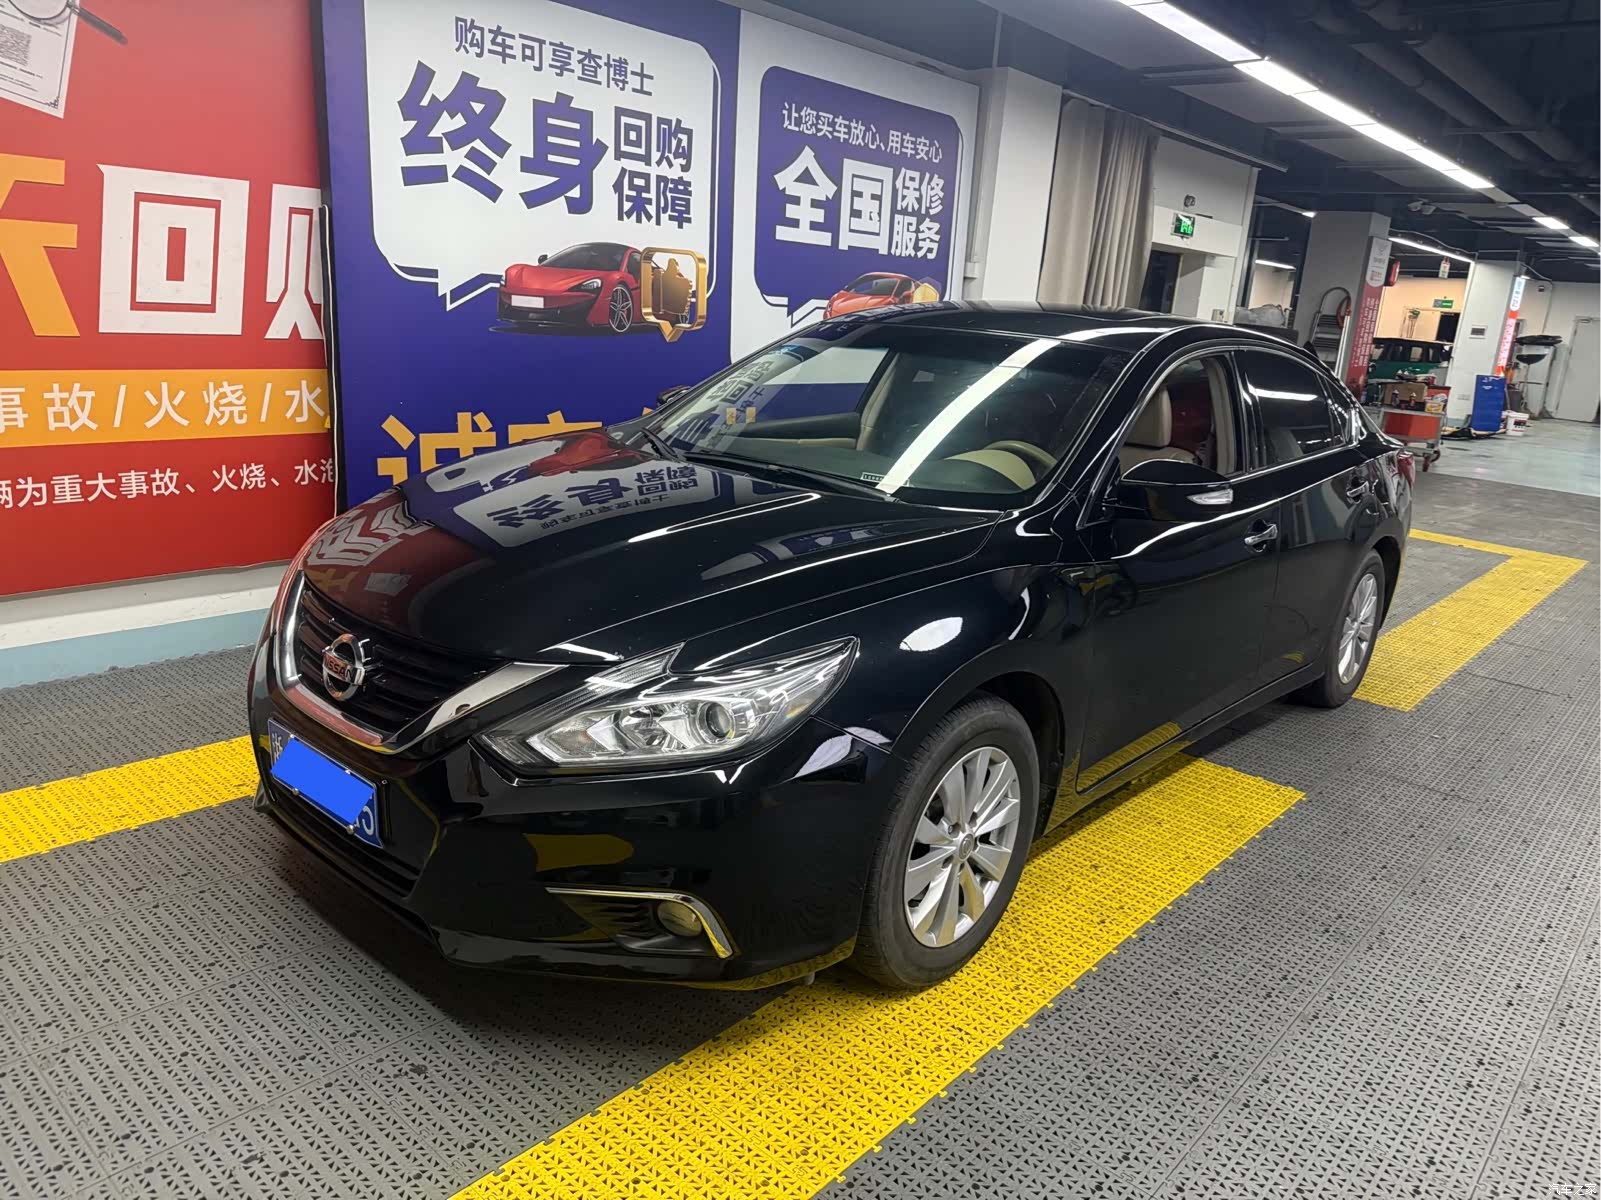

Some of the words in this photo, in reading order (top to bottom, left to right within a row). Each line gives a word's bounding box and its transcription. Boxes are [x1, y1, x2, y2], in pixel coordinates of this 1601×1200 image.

[454, 15, 654, 96] 购车可享查博士
[397, 59, 609, 215] 终身
[613, 105, 694, 173] 回购
[782, 102, 943, 163] 让您买车放心、用车安心
[612, 166, 693, 229] 保障
[773, 145, 894, 255] 全国
[895, 167, 945, 215] 保修
[890, 214, 941, 260] 服务
